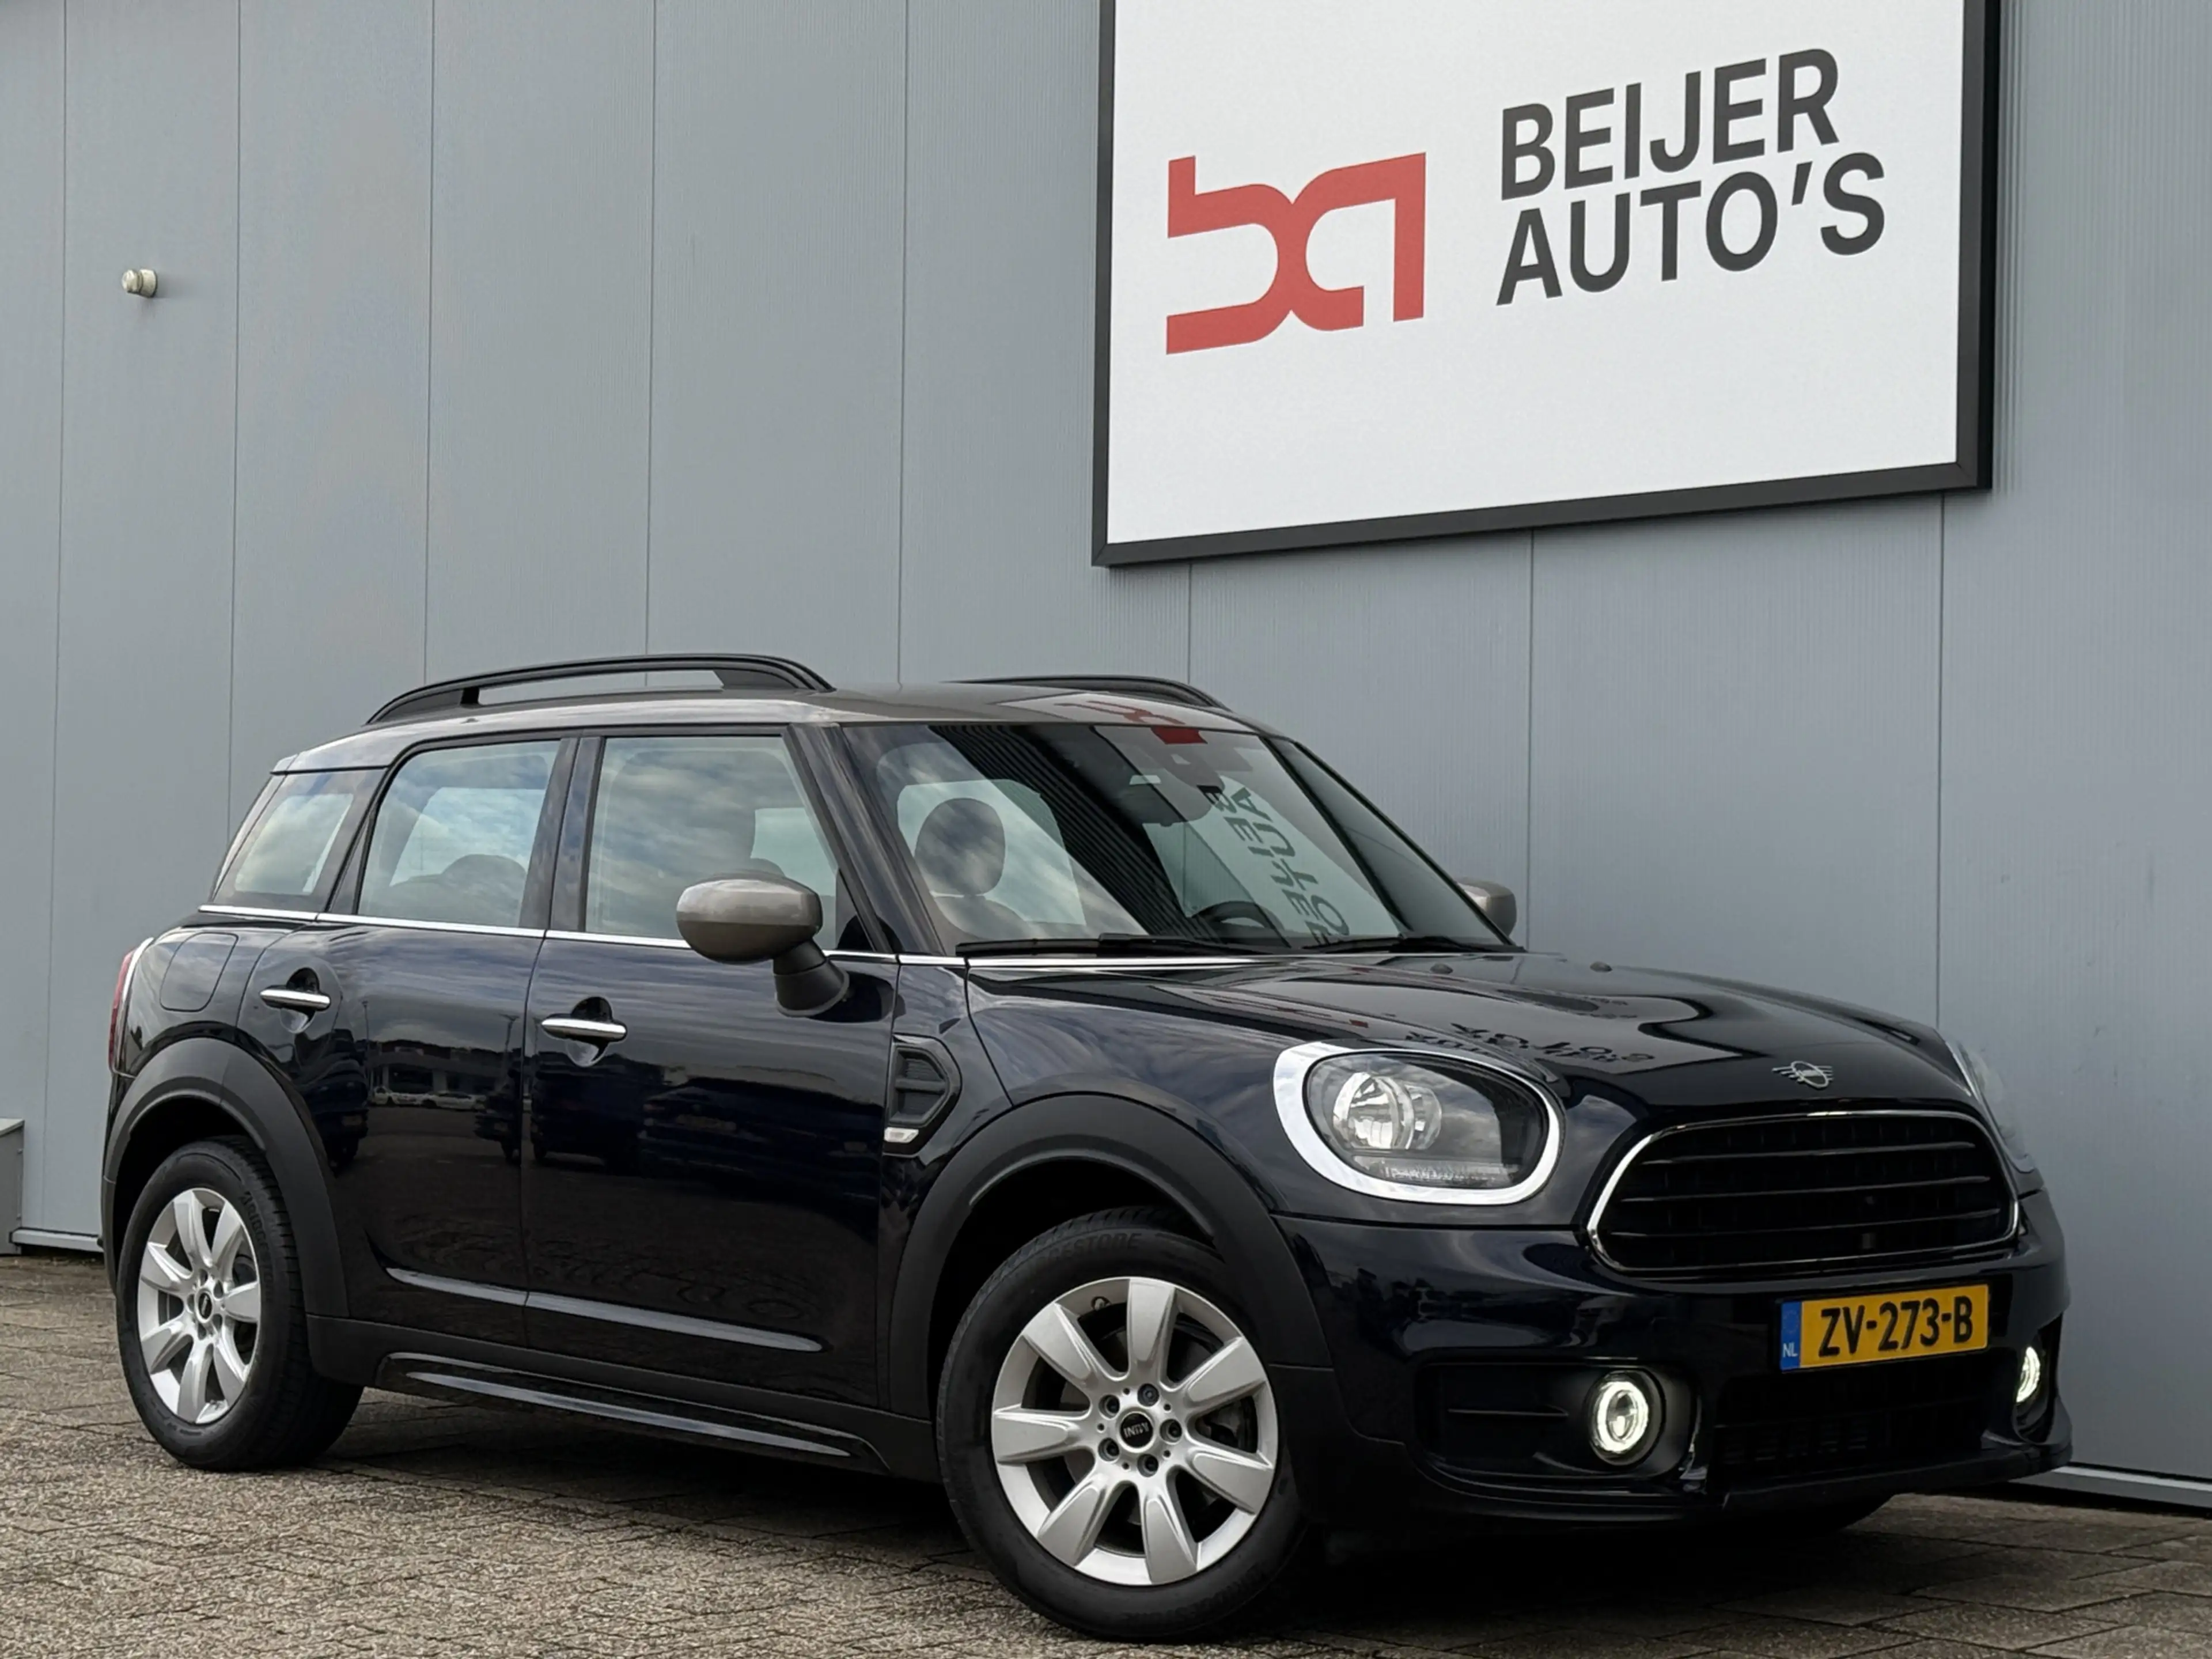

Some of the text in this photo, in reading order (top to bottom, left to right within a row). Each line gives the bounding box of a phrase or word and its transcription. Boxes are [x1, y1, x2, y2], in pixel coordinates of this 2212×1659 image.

[1502, 50, 1839, 200] BEIJER
[1497, 152, 1884, 305] AUTO'S
[1782, 1343, 1798, 1358] NL
[1818, 1295, 1974, 1358] ZV-273-B
